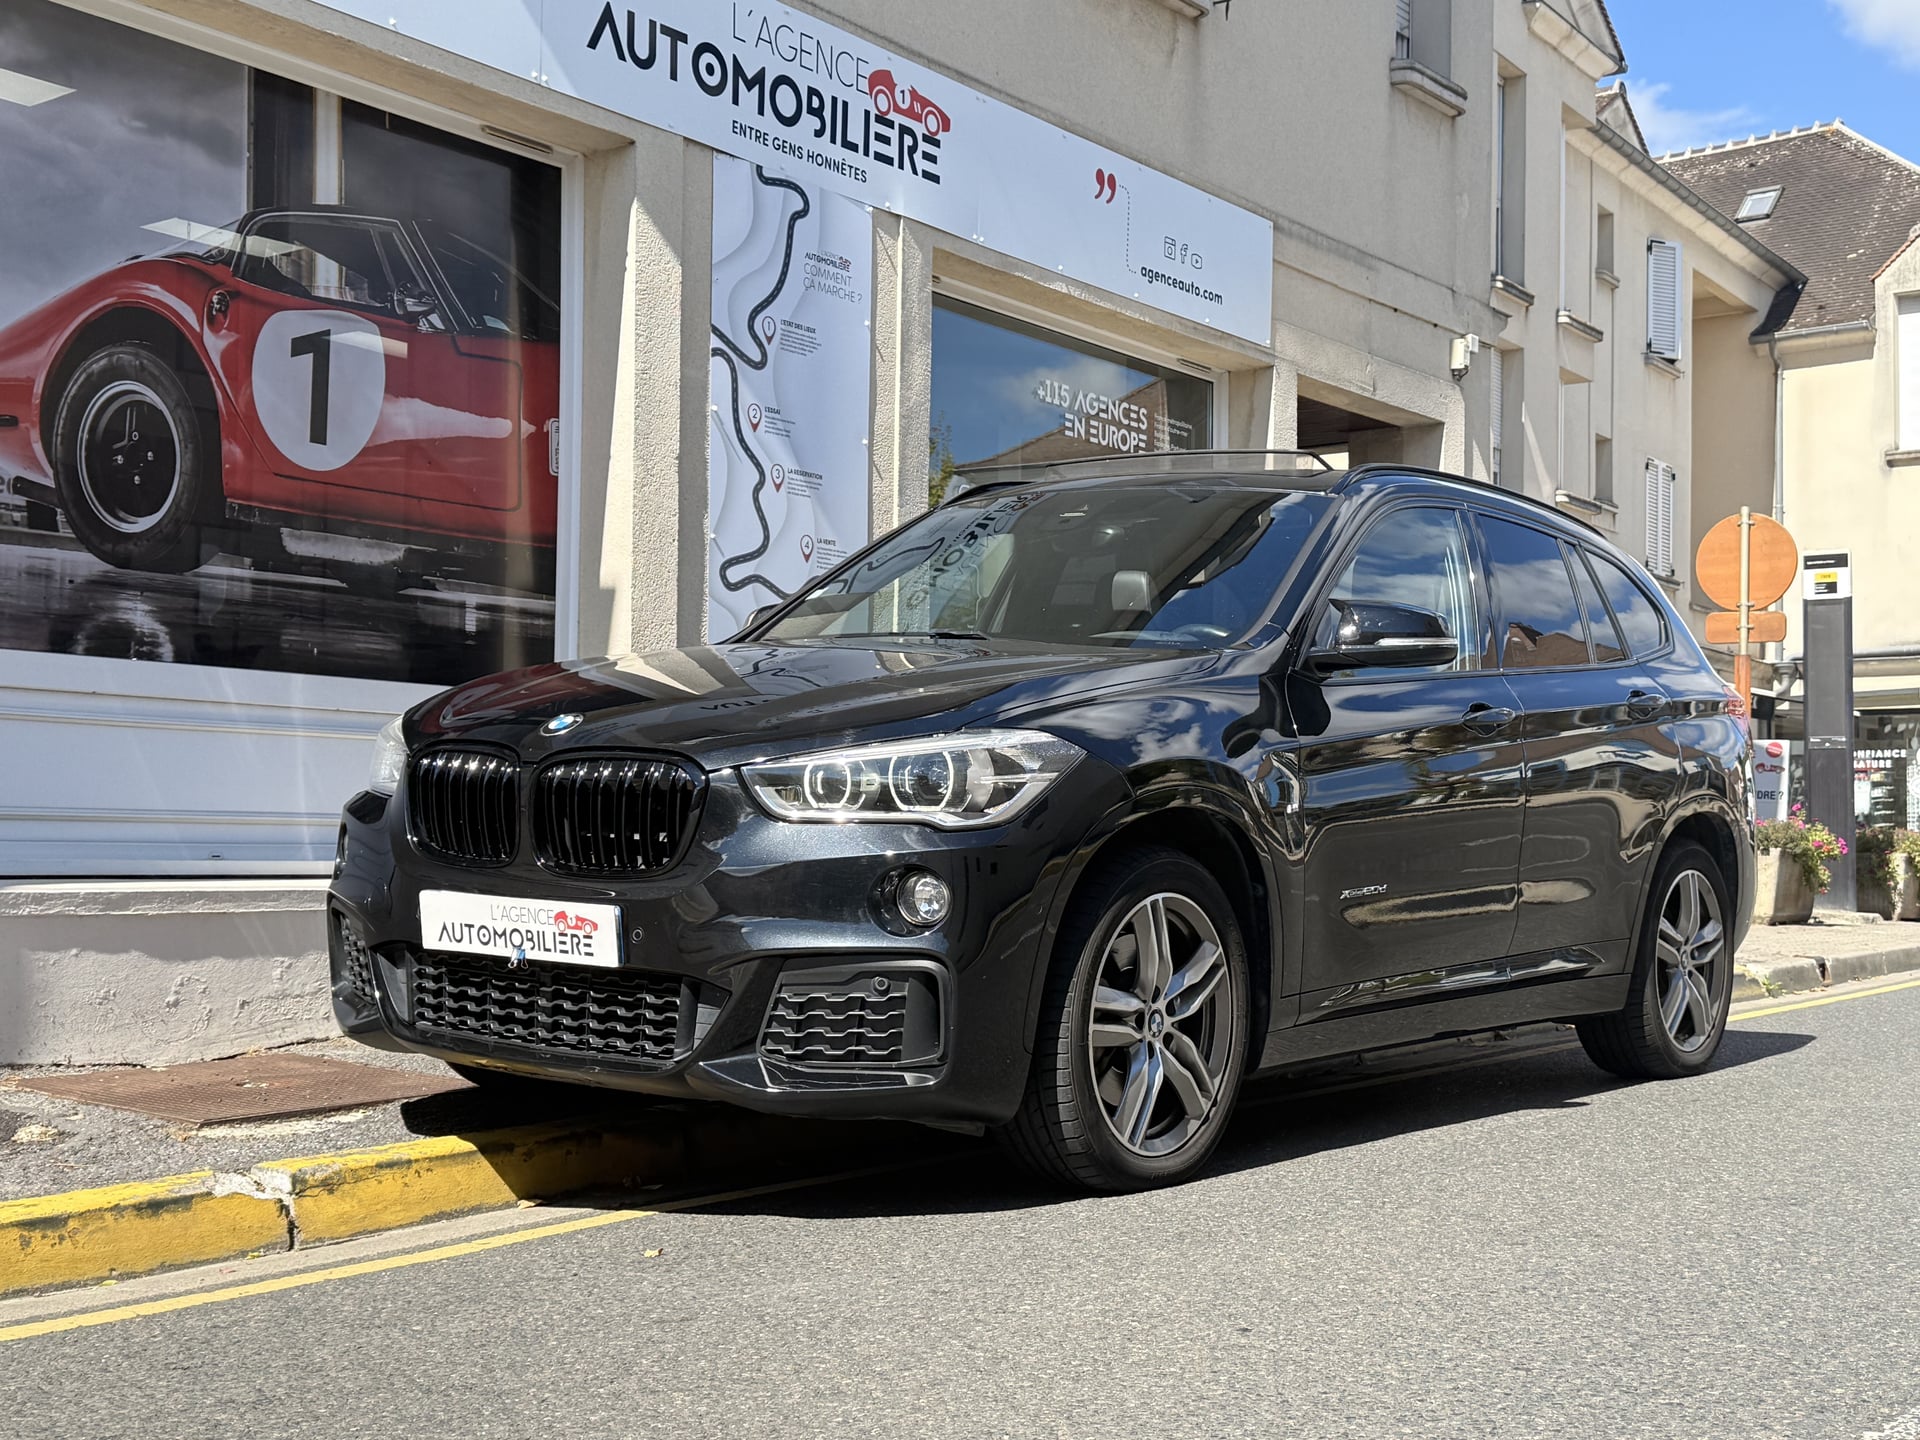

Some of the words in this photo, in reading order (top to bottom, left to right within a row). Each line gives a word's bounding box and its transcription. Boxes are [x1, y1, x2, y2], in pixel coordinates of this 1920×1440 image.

[732, 2, 870, 95] L'AGENCE
[731, 119, 769, 147] ENTRE
[772, 137, 804, 161] GENS
[806, 149, 868, 184] HONNÊTES
[803, 262, 852, 287] COMMENT
[1140, 266, 1223, 305] agenceauto.com
[817, 280, 856, 303] MARCHE
[290, 328, 331, 447] 1
[752, 408, 758, 419] 2
[1038, 379, 1070, 407] +115
[1074, 391, 1148, 431] AGENCES
[1064, 412, 1085, 440] EN
[1089, 422, 1148, 453] EUROPE
[775, 468, 781, 480] 3
[804, 538, 810, 550] 4
[489, 902, 555, 927] L'AGENCE
